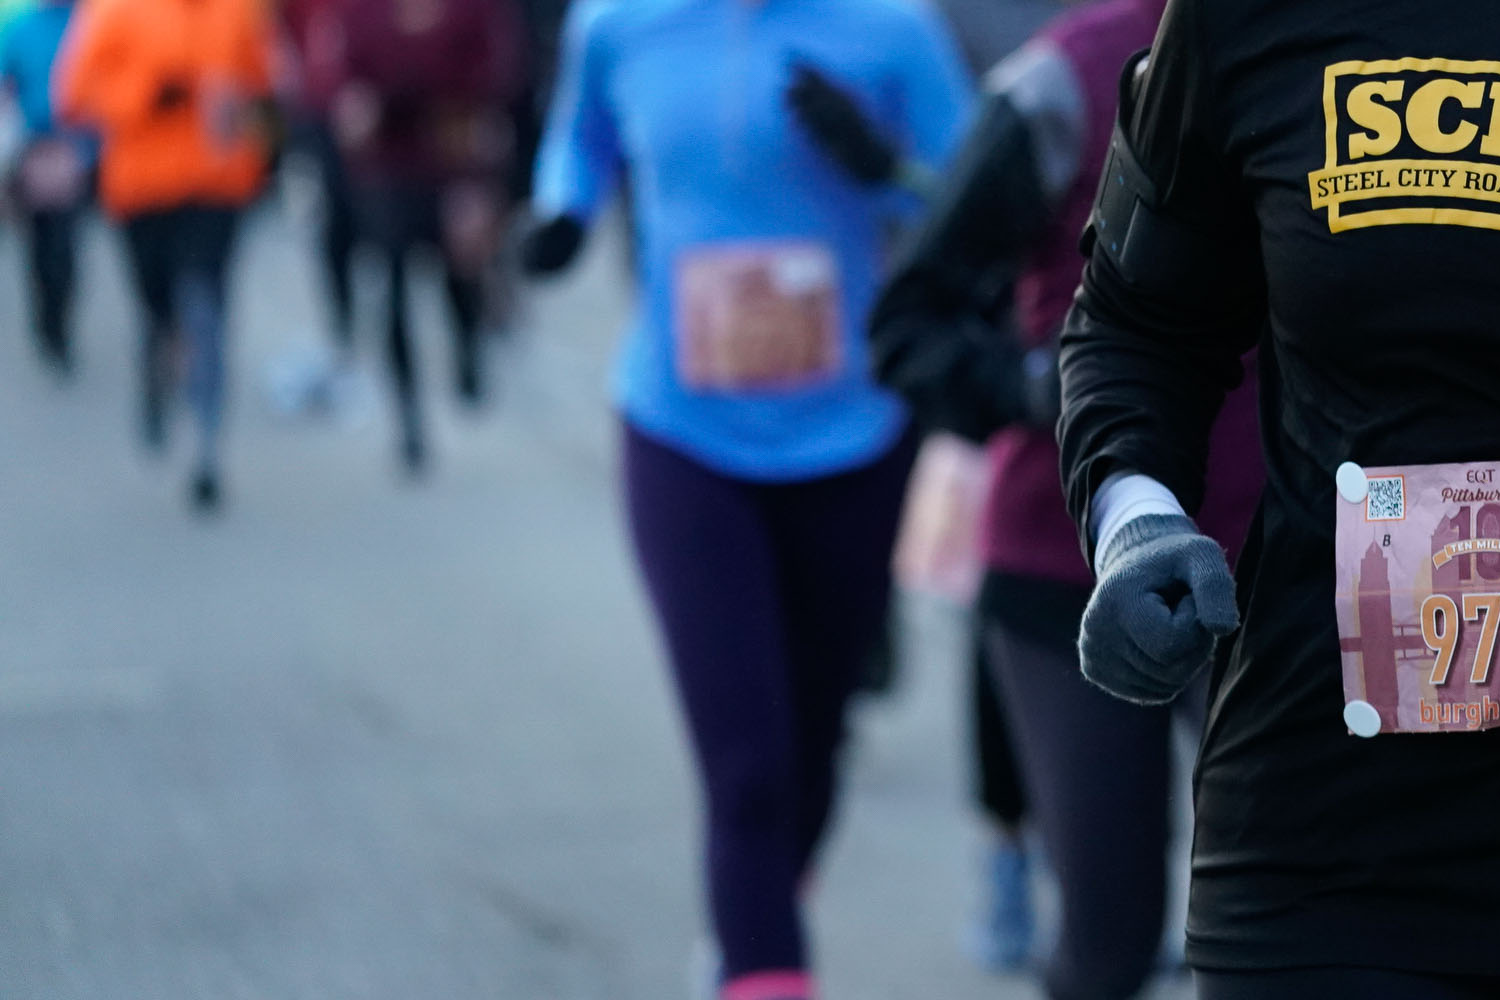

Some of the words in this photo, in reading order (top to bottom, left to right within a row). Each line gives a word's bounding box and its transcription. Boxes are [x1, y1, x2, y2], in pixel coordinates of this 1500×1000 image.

[1317, 169, 1390, 198] STEEL
[1398, 168, 1457, 188] CITY
[1466, 469, 1496, 484] EQT
[1450, 541, 1473, 553] TEN
